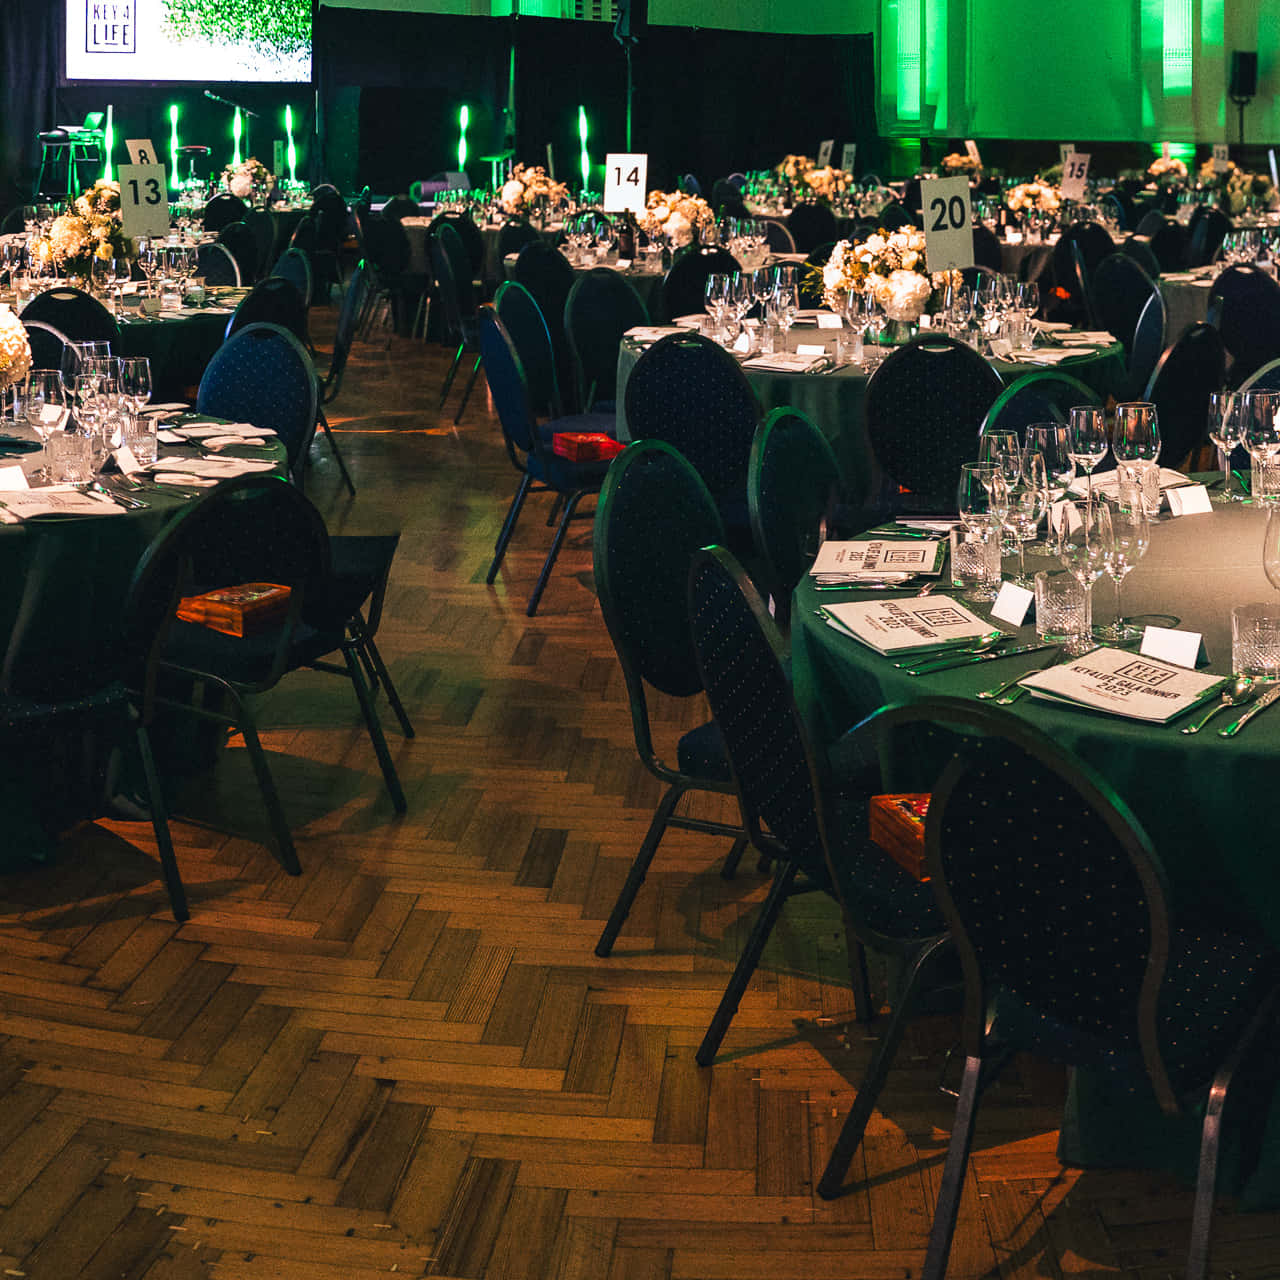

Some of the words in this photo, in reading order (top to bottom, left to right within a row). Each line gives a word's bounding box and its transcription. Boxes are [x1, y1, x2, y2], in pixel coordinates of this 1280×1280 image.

[93, 24, 130, 44] LIFE
[615, 167, 640, 186] 14
[1069, 162, 1086, 179] 15
[128, 178, 161, 205] 13
[930, 195, 966, 232] 20
[1071, 666, 1118, 682] KEY4LIFE
[1116, 680, 1140, 691] GALA
[1140, 687, 1181, 699] DINNER
[1124, 668, 1160, 682] LIFE
[1096, 682, 1132, 696] 2023
